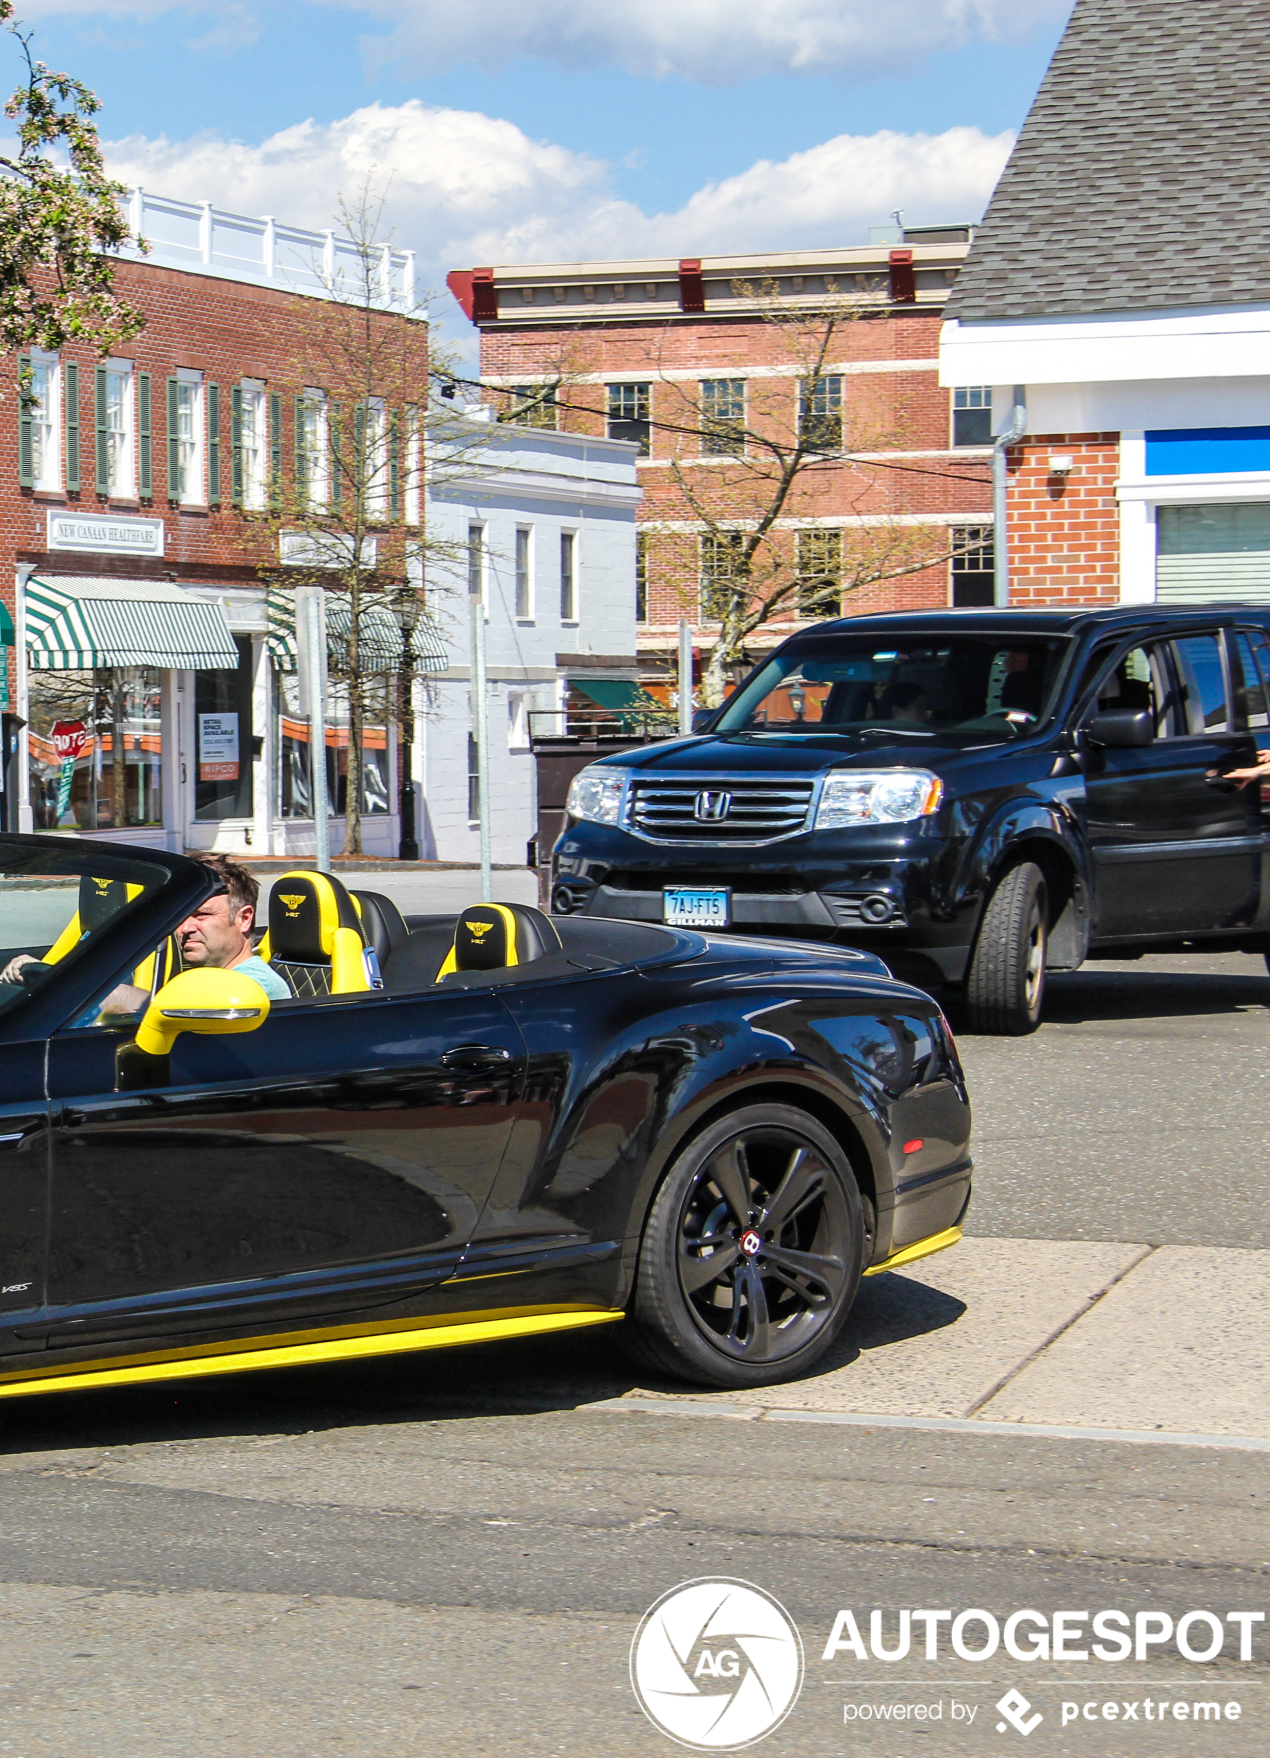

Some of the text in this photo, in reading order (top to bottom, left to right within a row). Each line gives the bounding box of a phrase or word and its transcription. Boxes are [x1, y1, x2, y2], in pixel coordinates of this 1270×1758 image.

[58, 523, 77, 538] NEW
[77, 525, 108, 541] CANAAN
[204, 764, 235, 773] RIPCO
[666, 918, 725, 927] GILLMAN
